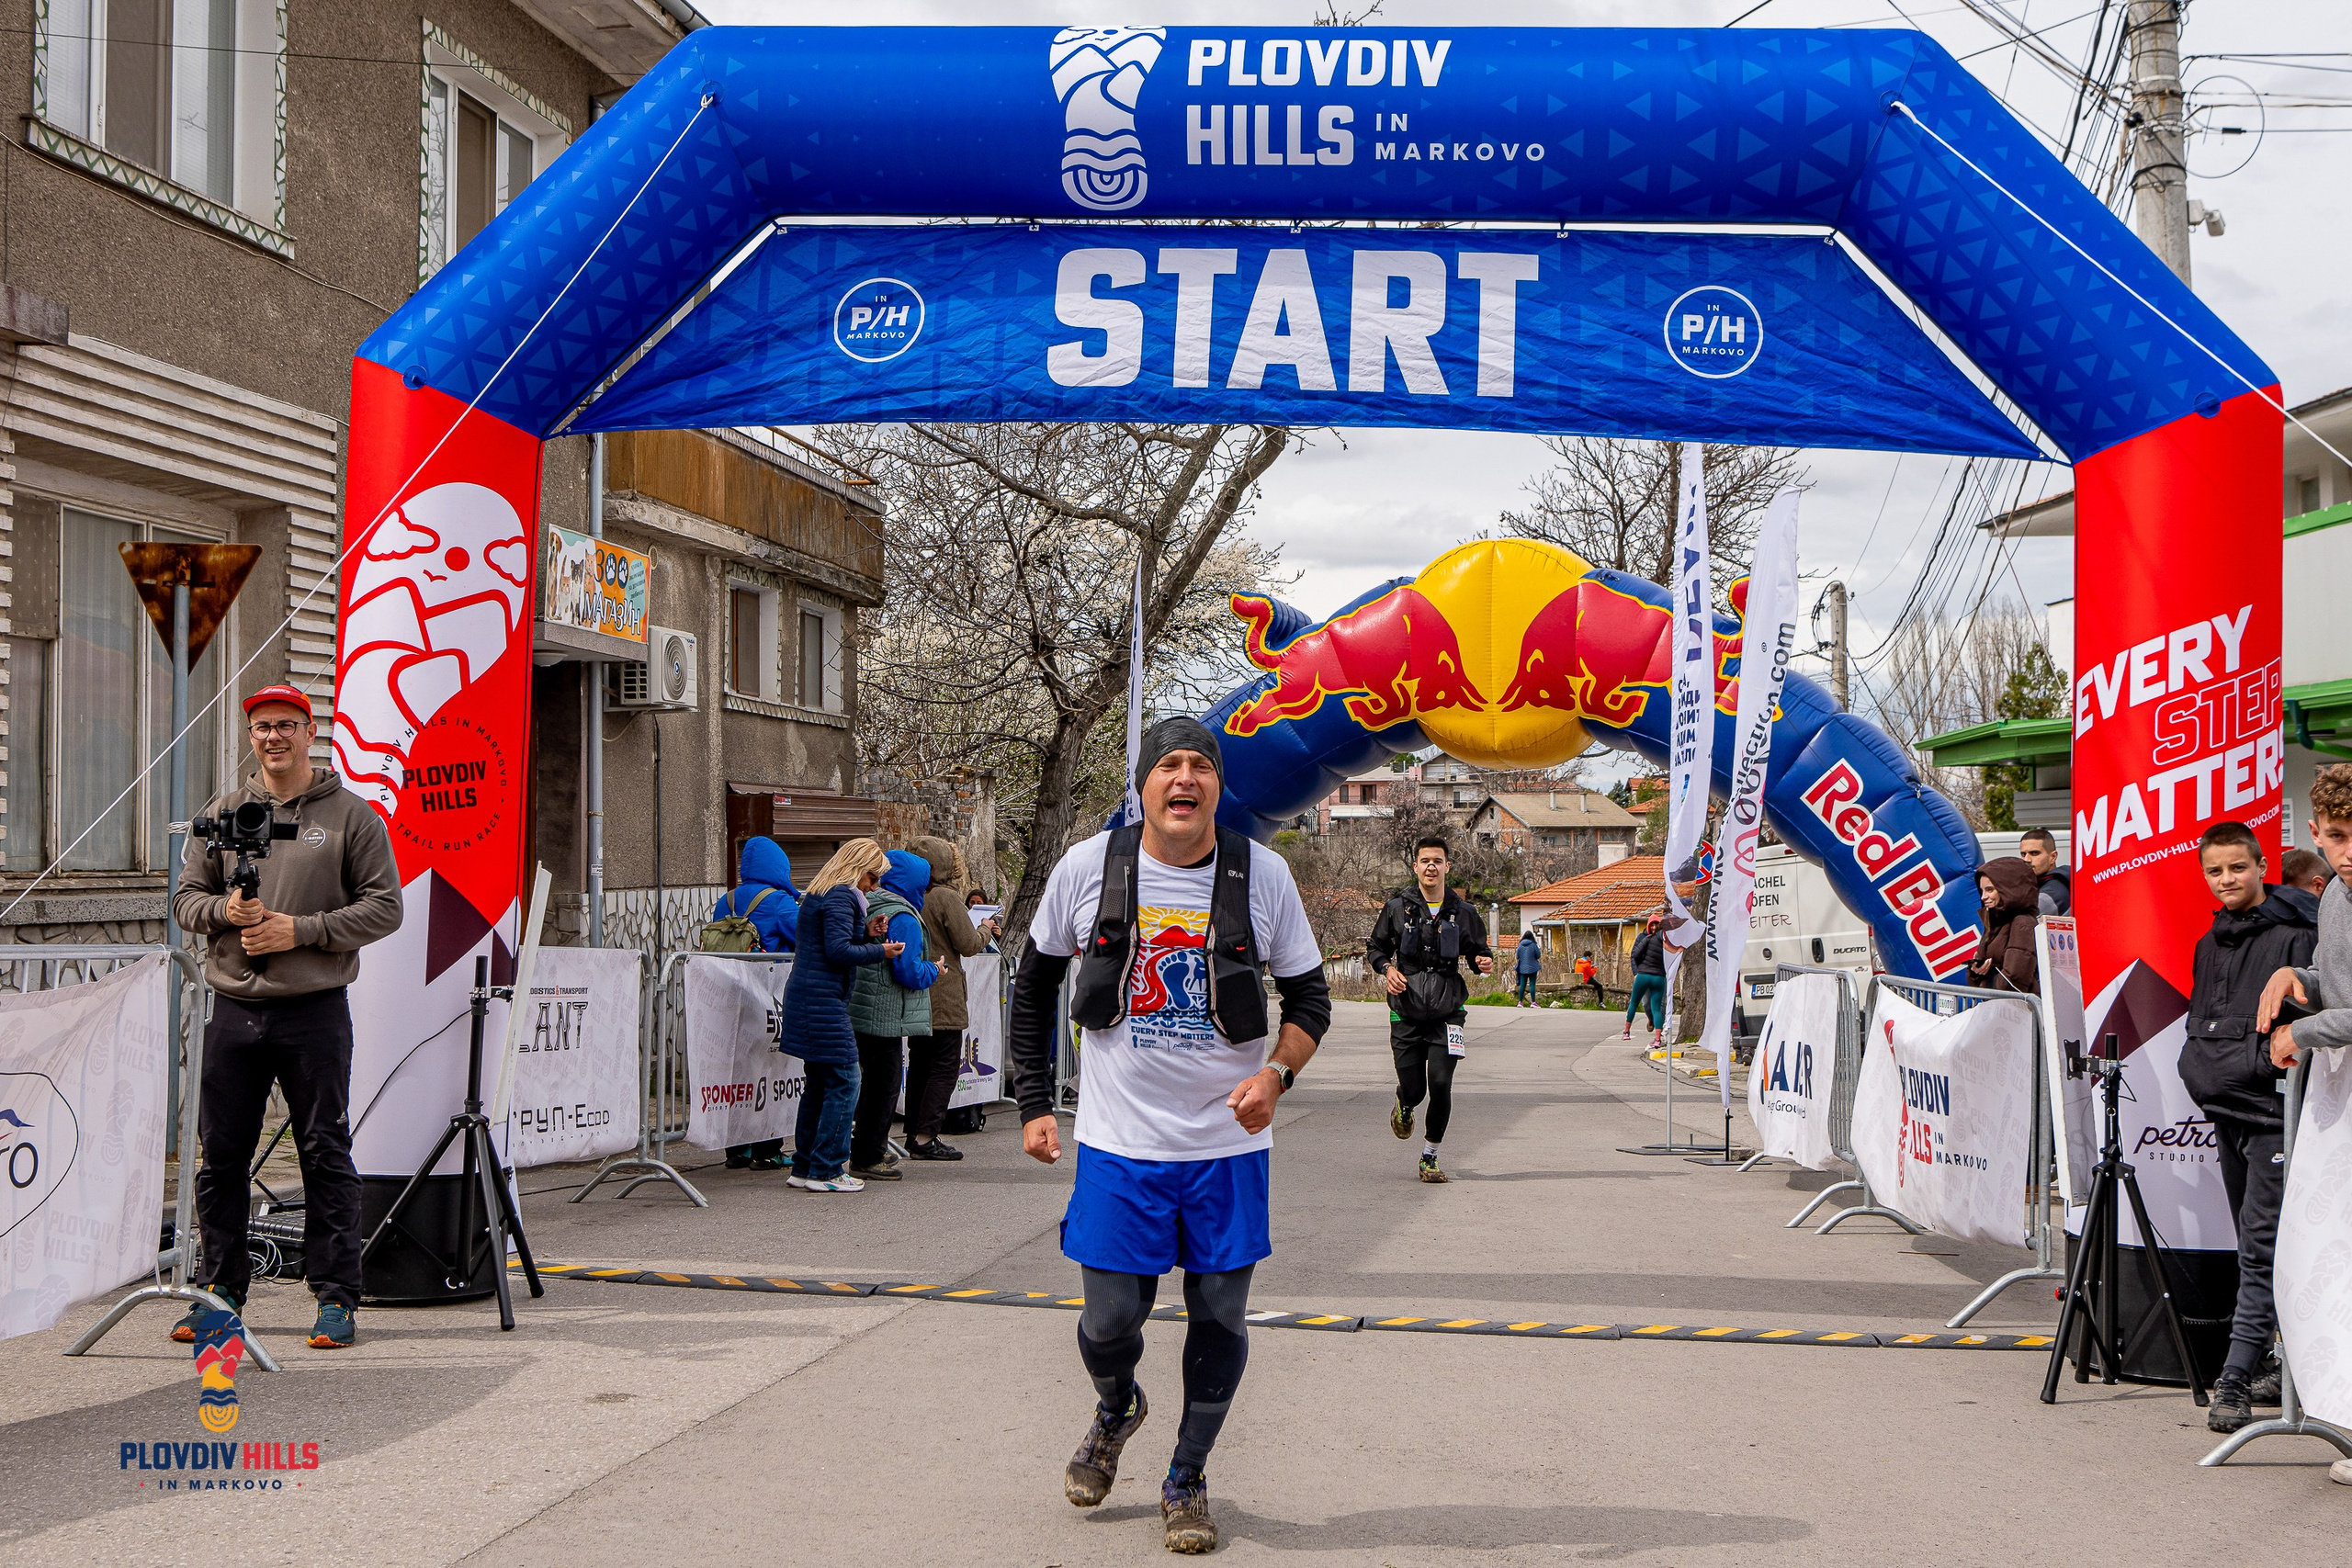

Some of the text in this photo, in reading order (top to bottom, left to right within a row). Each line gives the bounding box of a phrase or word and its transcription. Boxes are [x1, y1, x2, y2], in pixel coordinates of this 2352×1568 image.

[1187, 39, 1453, 87] PLOVDIV
[1186, 104, 1354, 166] HILLS
[1375, 112, 1408, 132] IN
[1375, 141, 1545, 162] MARKOVO
[875, 295, 887, 303] IN
[850, 305, 910, 331] P/H
[1046, 247, 1539, 398] START
[1682, 313, 1745, 344] P/H
[846, 332, 906, 340] MARKOVO
[1682, 345, 1745, 356] MARKOVO
[583, 591, 641, 636] МАГАЗИН
[2075, 604, 2253, 740] EVERY
[2153, 656, 2281, 765] STEP
[401, 760, 487, 790] PLOVDIV
[421, 787, 477, 813] HILLS
[396, 811, 501, 852] TRAIL RUN RACE
[1804, 762, 1917, 877] Red
[1749, 914, 1792, 929] EITER
[1883, 863, 1981, 977] Bull
[1833, 946, 1867, 954] DUCATO
[1131, 1026, 1215, 1041] EVERY STEP MATTERS
[701, 1083, 753, 1113] SPONSER
[1934, 1131, 1944, 1145] IN
[1936, 1150, 1987, 1171] MARKOVO
[2149, 1151, 2204, 1163] STUDIO
